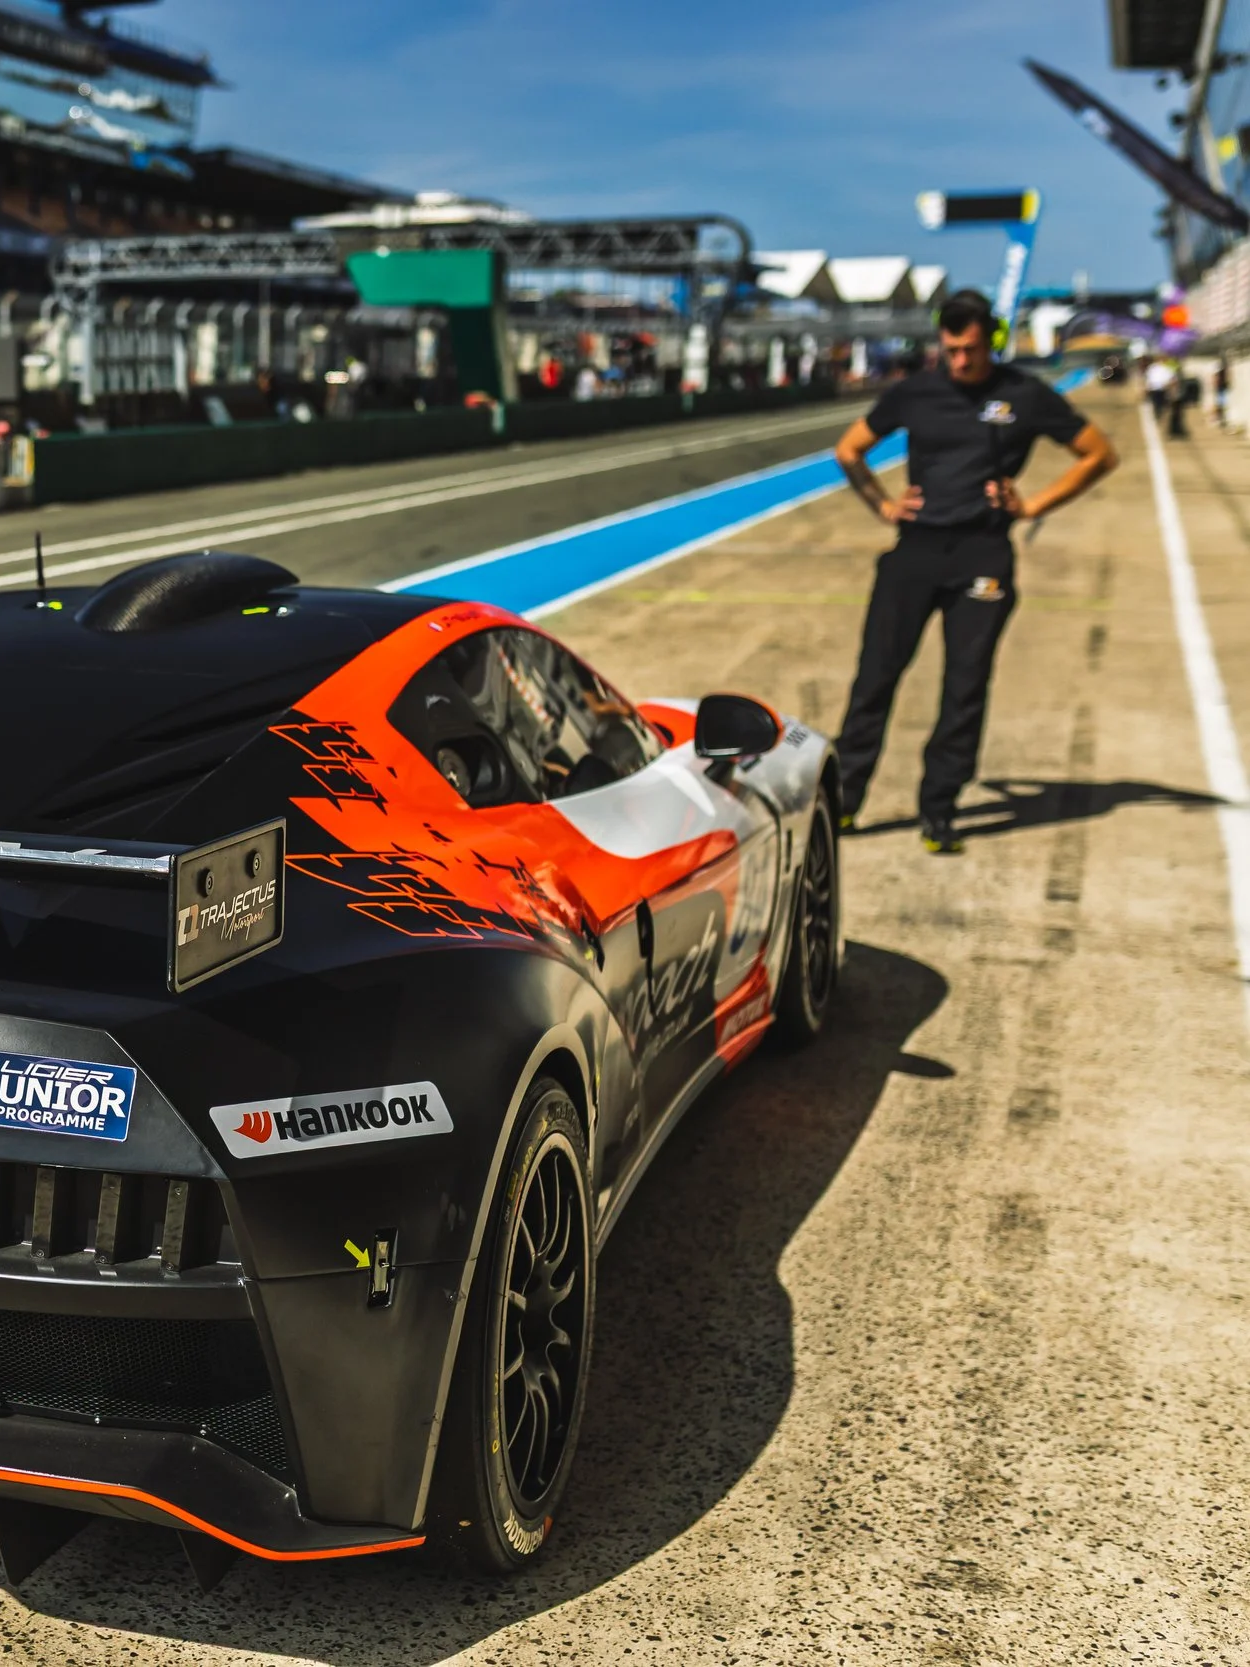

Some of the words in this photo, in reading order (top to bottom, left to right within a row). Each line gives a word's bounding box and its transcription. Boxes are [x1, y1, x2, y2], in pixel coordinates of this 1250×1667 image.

[201, 879, 277, 930] TRAJECTUS
[221, 903, 274, 940] Motorsport
[0, 1060, 114, 1085] LIGIER
